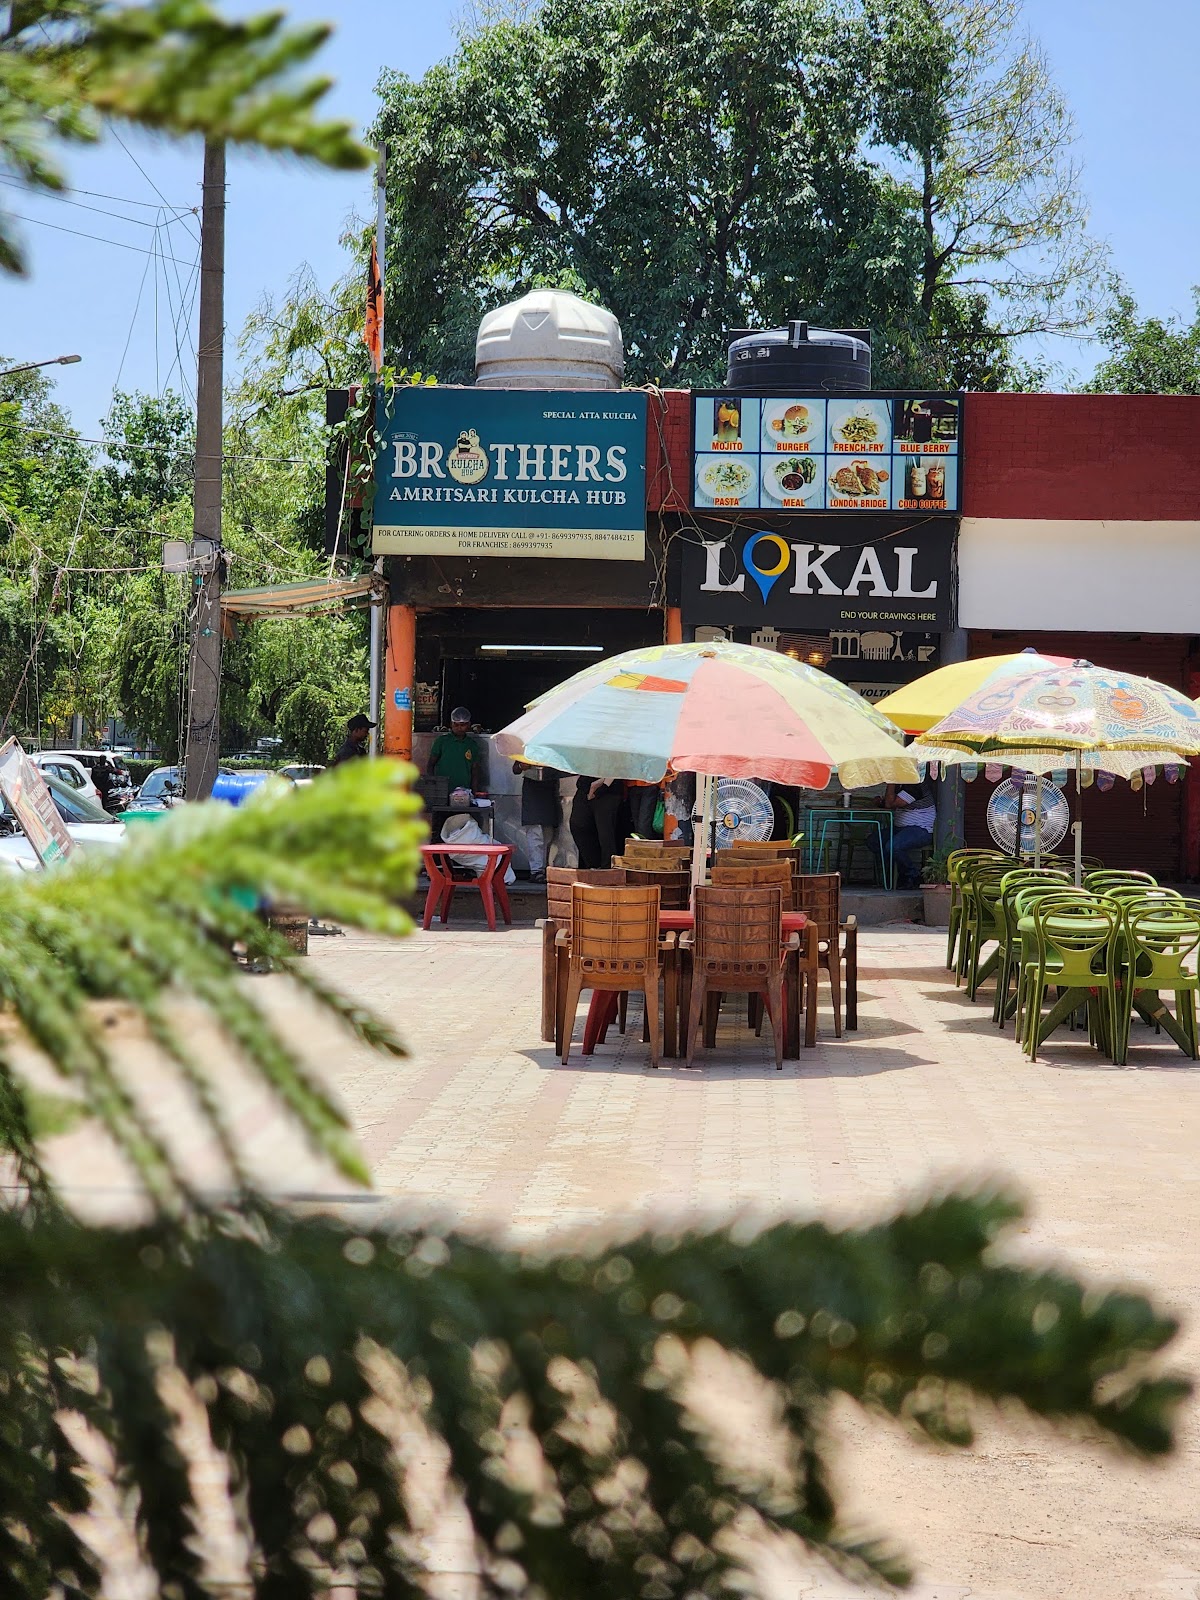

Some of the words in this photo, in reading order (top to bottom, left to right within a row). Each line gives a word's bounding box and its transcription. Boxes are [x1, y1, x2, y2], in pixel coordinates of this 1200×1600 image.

[602, 412, 638, 420] KULCHA
[712, 442, 743, 450] MOJITO
[776, 442, 809, 452] BURGER
[900, 444, 920, 452] BLUE
[924, 444, 950, 452] BERRY
[451, 459, 484, 470] KULCHA
[389, 486, 498, 502] AMRITSARI
[503, 489, 580, 504] KULCHA
[586, 490, 627, 505] HUB
[714, 498, 739, 506] PASTA
[783, 498, 805, 507] MEAL
[898, 499, 918, 508] COLD
[919, 500, 947, 509] COFFEE
[424, 530, 451, 538] ORDERS
[479, 531, 510, 539] DELIVERY
[594, 534, 635, 542] 8847484215
[458, 540, 472, 548] FOR
[512, 541, 553, 550] 8699397935
[840, 610, 856, 619] END
[858, 612, 878, 620] YOUR
[879, 612, 916, 620] CRAVINGS
[860, 689, 899, 698] VOLTA
